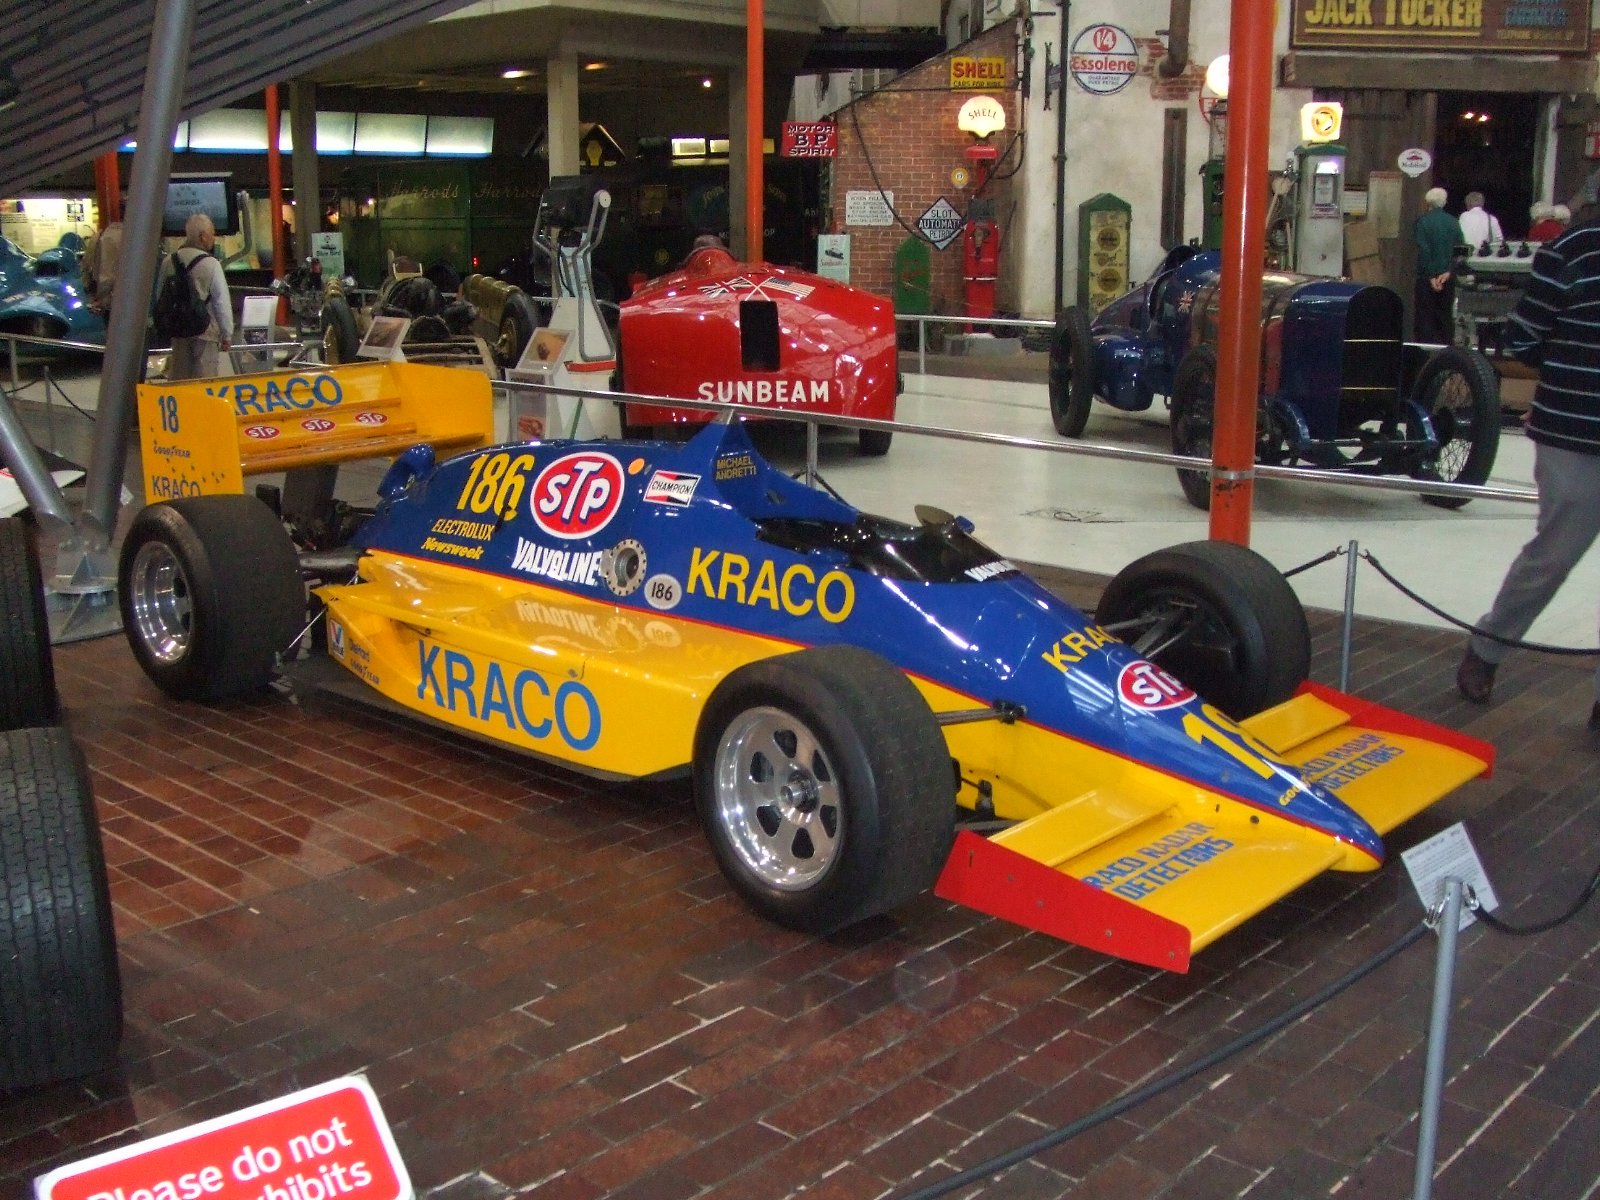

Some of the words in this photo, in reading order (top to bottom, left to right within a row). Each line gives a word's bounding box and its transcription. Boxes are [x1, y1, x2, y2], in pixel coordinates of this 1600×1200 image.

[1305, 0, 1373, 25] JACK
[953, 61, 1004, 79] SHELL
[1071, 55, 1136, 72] Essolene
[968, 108, 998, 121] SHELL
[788, 124, 835, 134] MOTOR
[789, 147, 835, 157] SPIRIT
[931, 209, 953, 218] SLOT
[697, 380, 829, 404] SUNBEAM
[157, 395, 180, 434] 18
[306, 419, 334, 432] STP
[360, 413, 384, 425] STP
[248, 426, 277, 438] STP
[716, 465, 757, 480] ANDRETTI
[717, 455, 752, 469] MICHAEL
[151, 475, 201, 499] KRACO
[456, 453, 535, 522] 186
[539, 460, 611, 521] STP
[651, 480, 692, 495] CHAMPION
[431, 518, 496, 541] ELECTROLUX
[420, 536, 486, 561] Newsweek
[511, 536, 603, 587] VALVOLINE
[650, 582, 673, 601] 186
[686, 547, 856, 623] KRACO
[416, 639, 602, 751] KRACO
[1136, 822, 1216, 860] RADAR
[1112, 836, 1234, 900] DETECTORS
[232, 1145, 282, 1181] do
[288, 1116, 353, 1163] not
